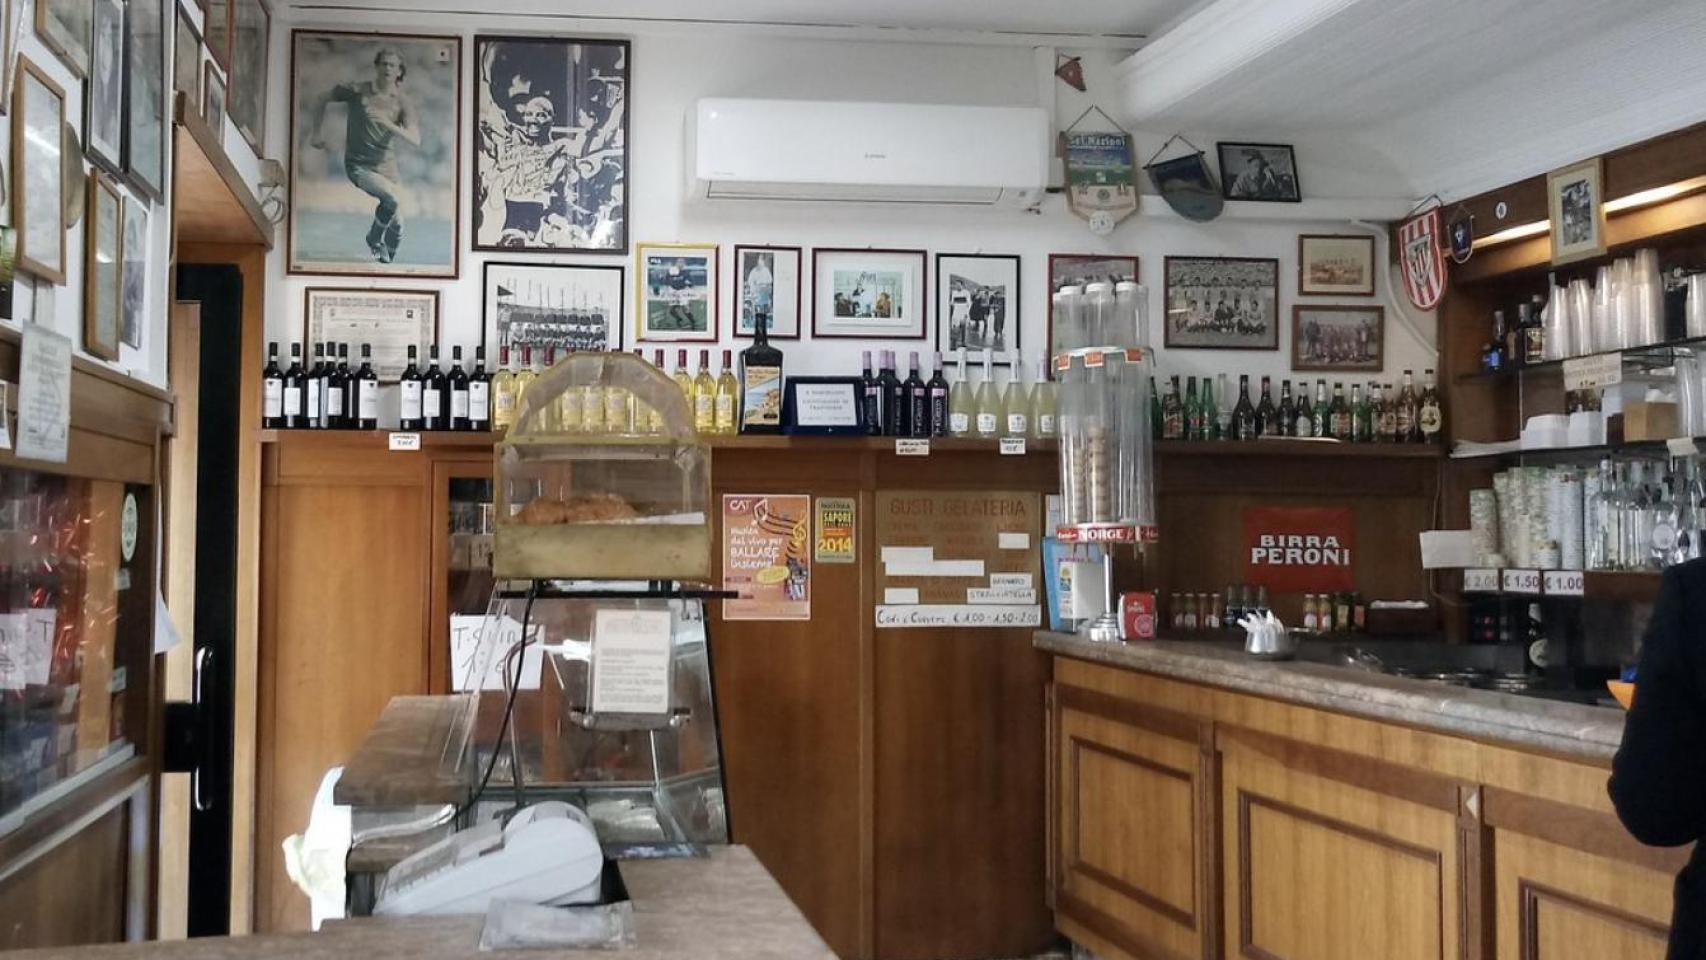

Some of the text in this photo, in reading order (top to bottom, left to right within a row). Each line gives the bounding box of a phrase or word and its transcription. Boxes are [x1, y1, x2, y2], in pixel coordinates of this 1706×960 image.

[890, 499, 1027, 517] GUSTI GELATERIA
[817, 536, 853, 552] 2014
[1260, 534, 1340, 548] BIRRA
[1251, 547, 1351, 566] PERONI
[1514, 575, 1539, 588] 1.50
[1556, 576, 1584, 591] 1.00
